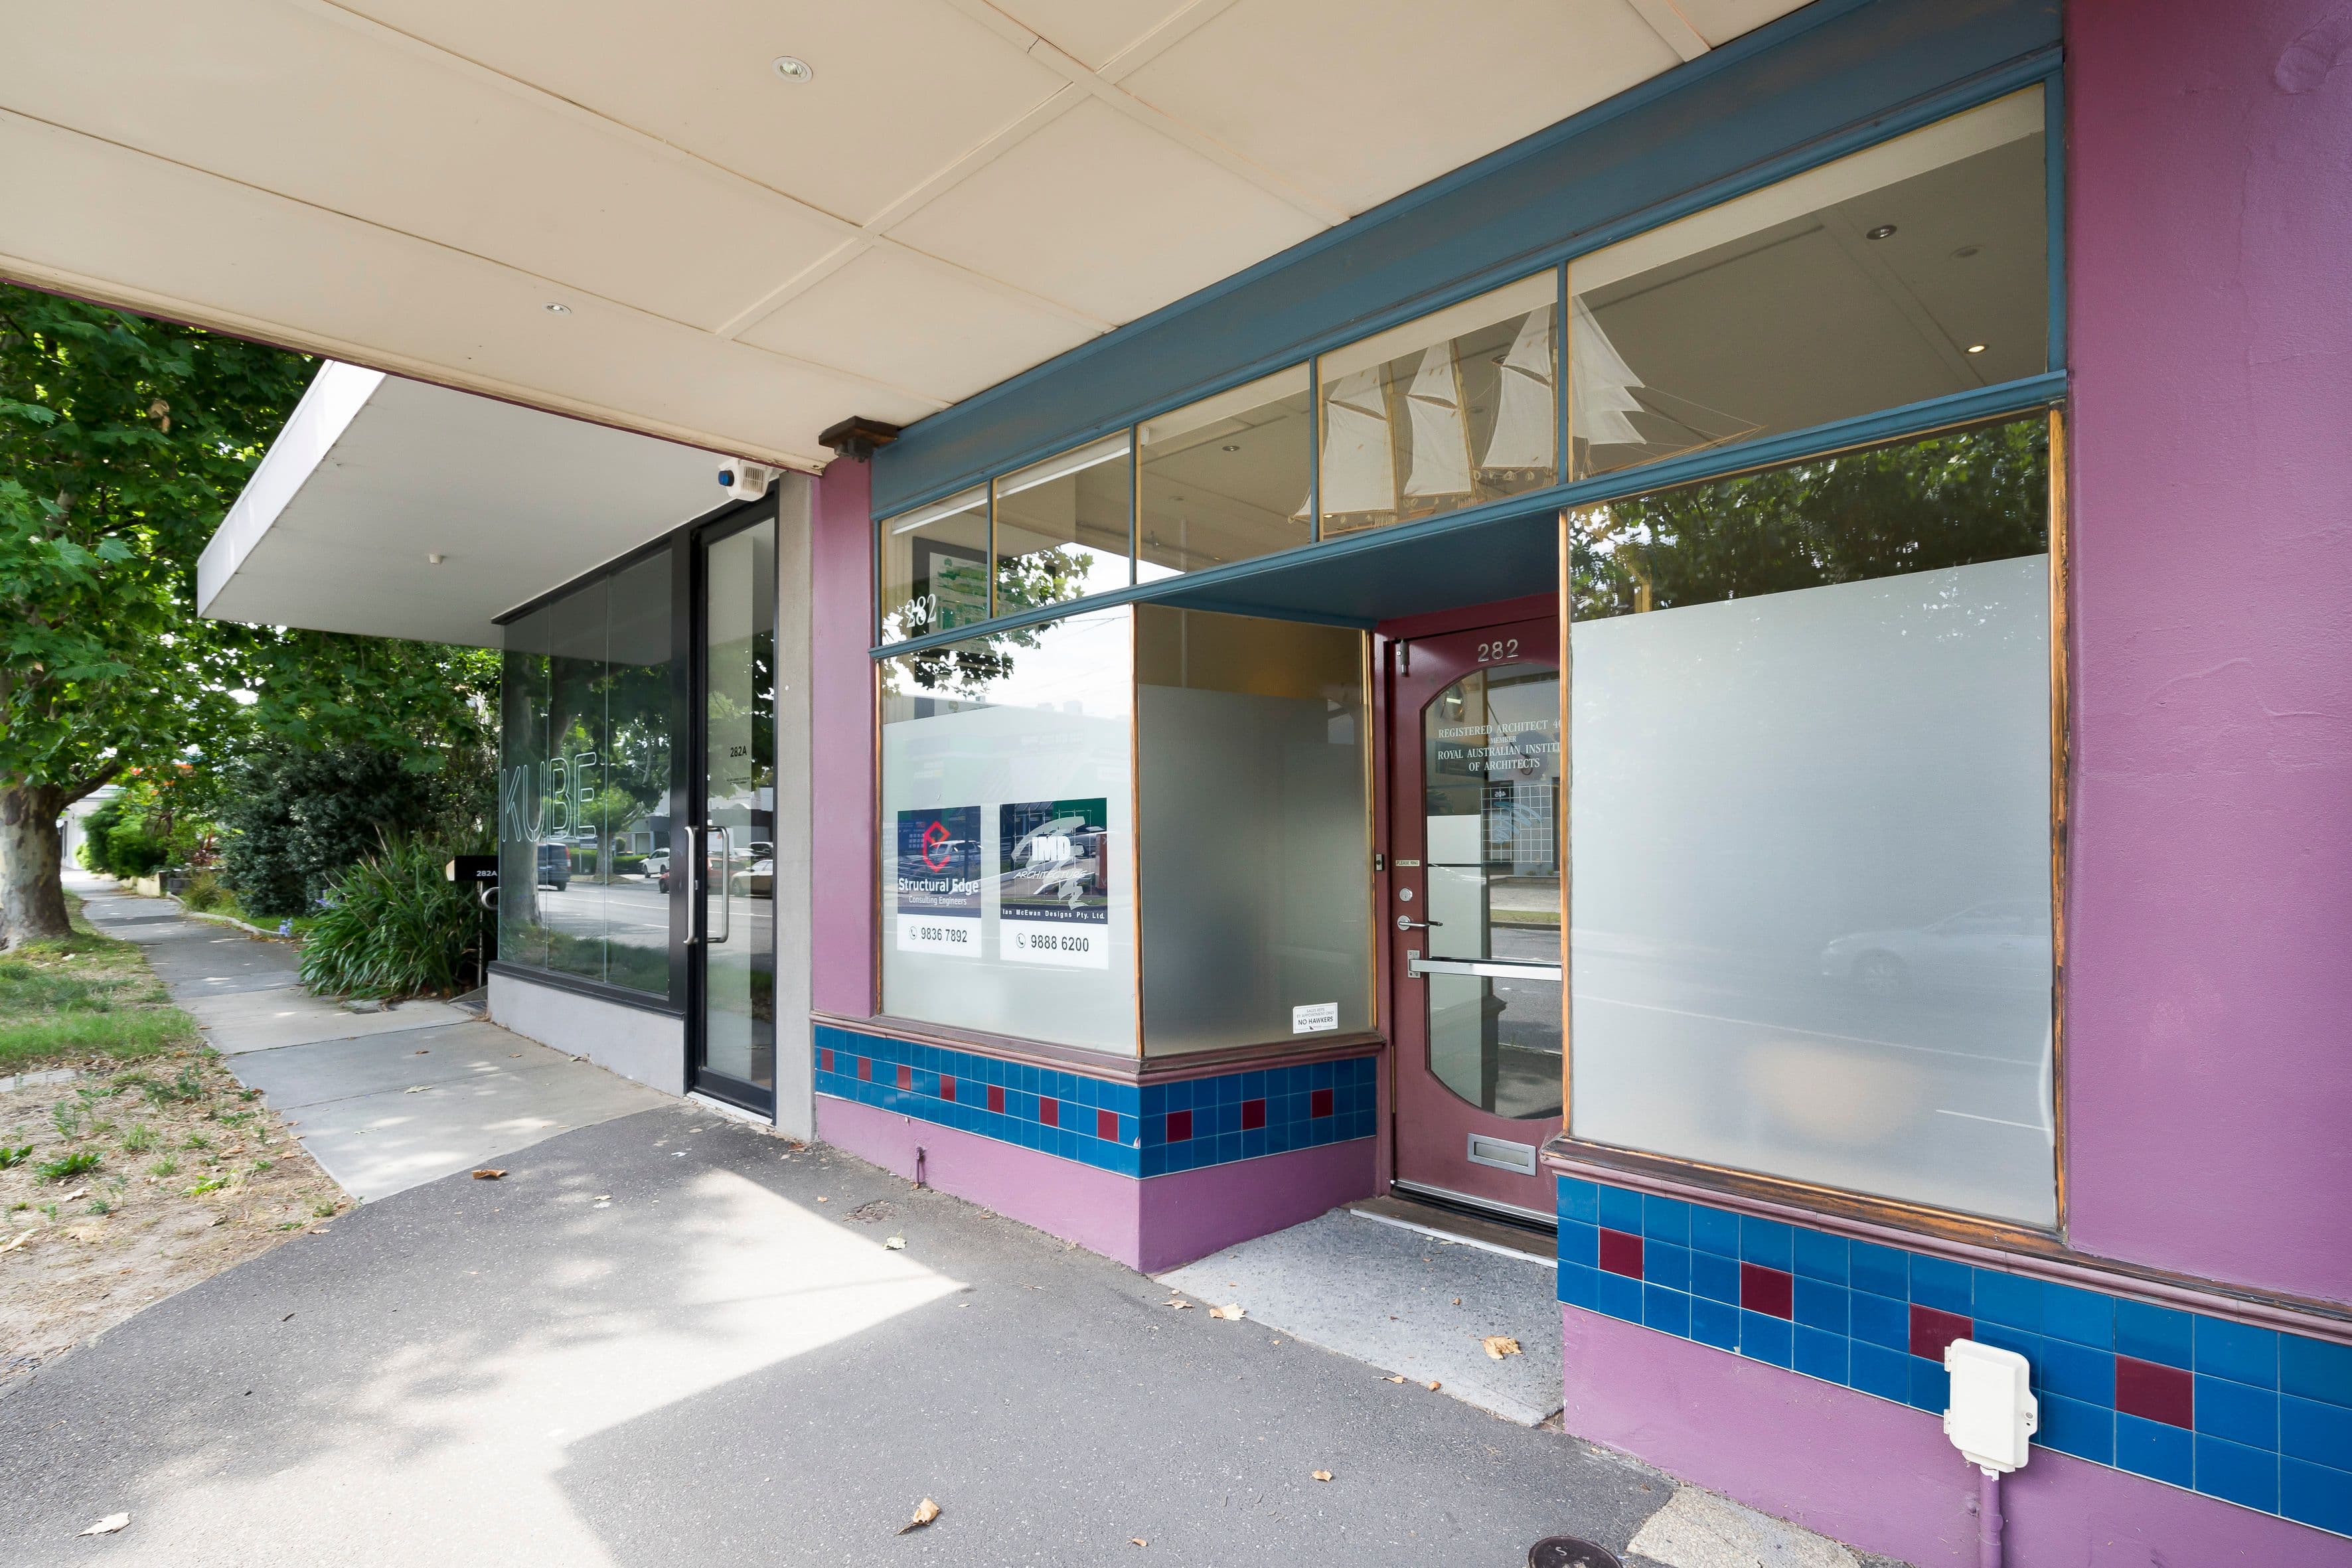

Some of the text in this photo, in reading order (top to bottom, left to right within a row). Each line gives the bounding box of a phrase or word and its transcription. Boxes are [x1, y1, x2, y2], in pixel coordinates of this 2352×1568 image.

[906, 593, 937, 628] 282
[1477, 639, 1520, 663] 282
[1438, 724, 1492, 738] REGISTERED
[1496, 720, 1548, 734] ARCHITECT
[1490, 736, 1517, 744] MEMBER
[730, 745, 747, 757] 282A
[1438, 749, 1464, 760] ROYAL
[1467, 745, 1520, 758] AUSTRALIAN
[1468, 758, 1540, 772] OF ARCHITECTS
[502, 751, 597, 842] KUBE
[1014, 870, 1087, 880] ARCHITECTURE
[898, 878, 979, 896] Structural Edge
[909, 896, 967, 906] Consulting Engineers
[1076, 911, 1089, 920] Pty.
[921, 927, 967, 943] 9836 7892
[1031, 935, 1089, 953] 9888 6200
[1308, 1016, 1334, 1024] HAWKERS
